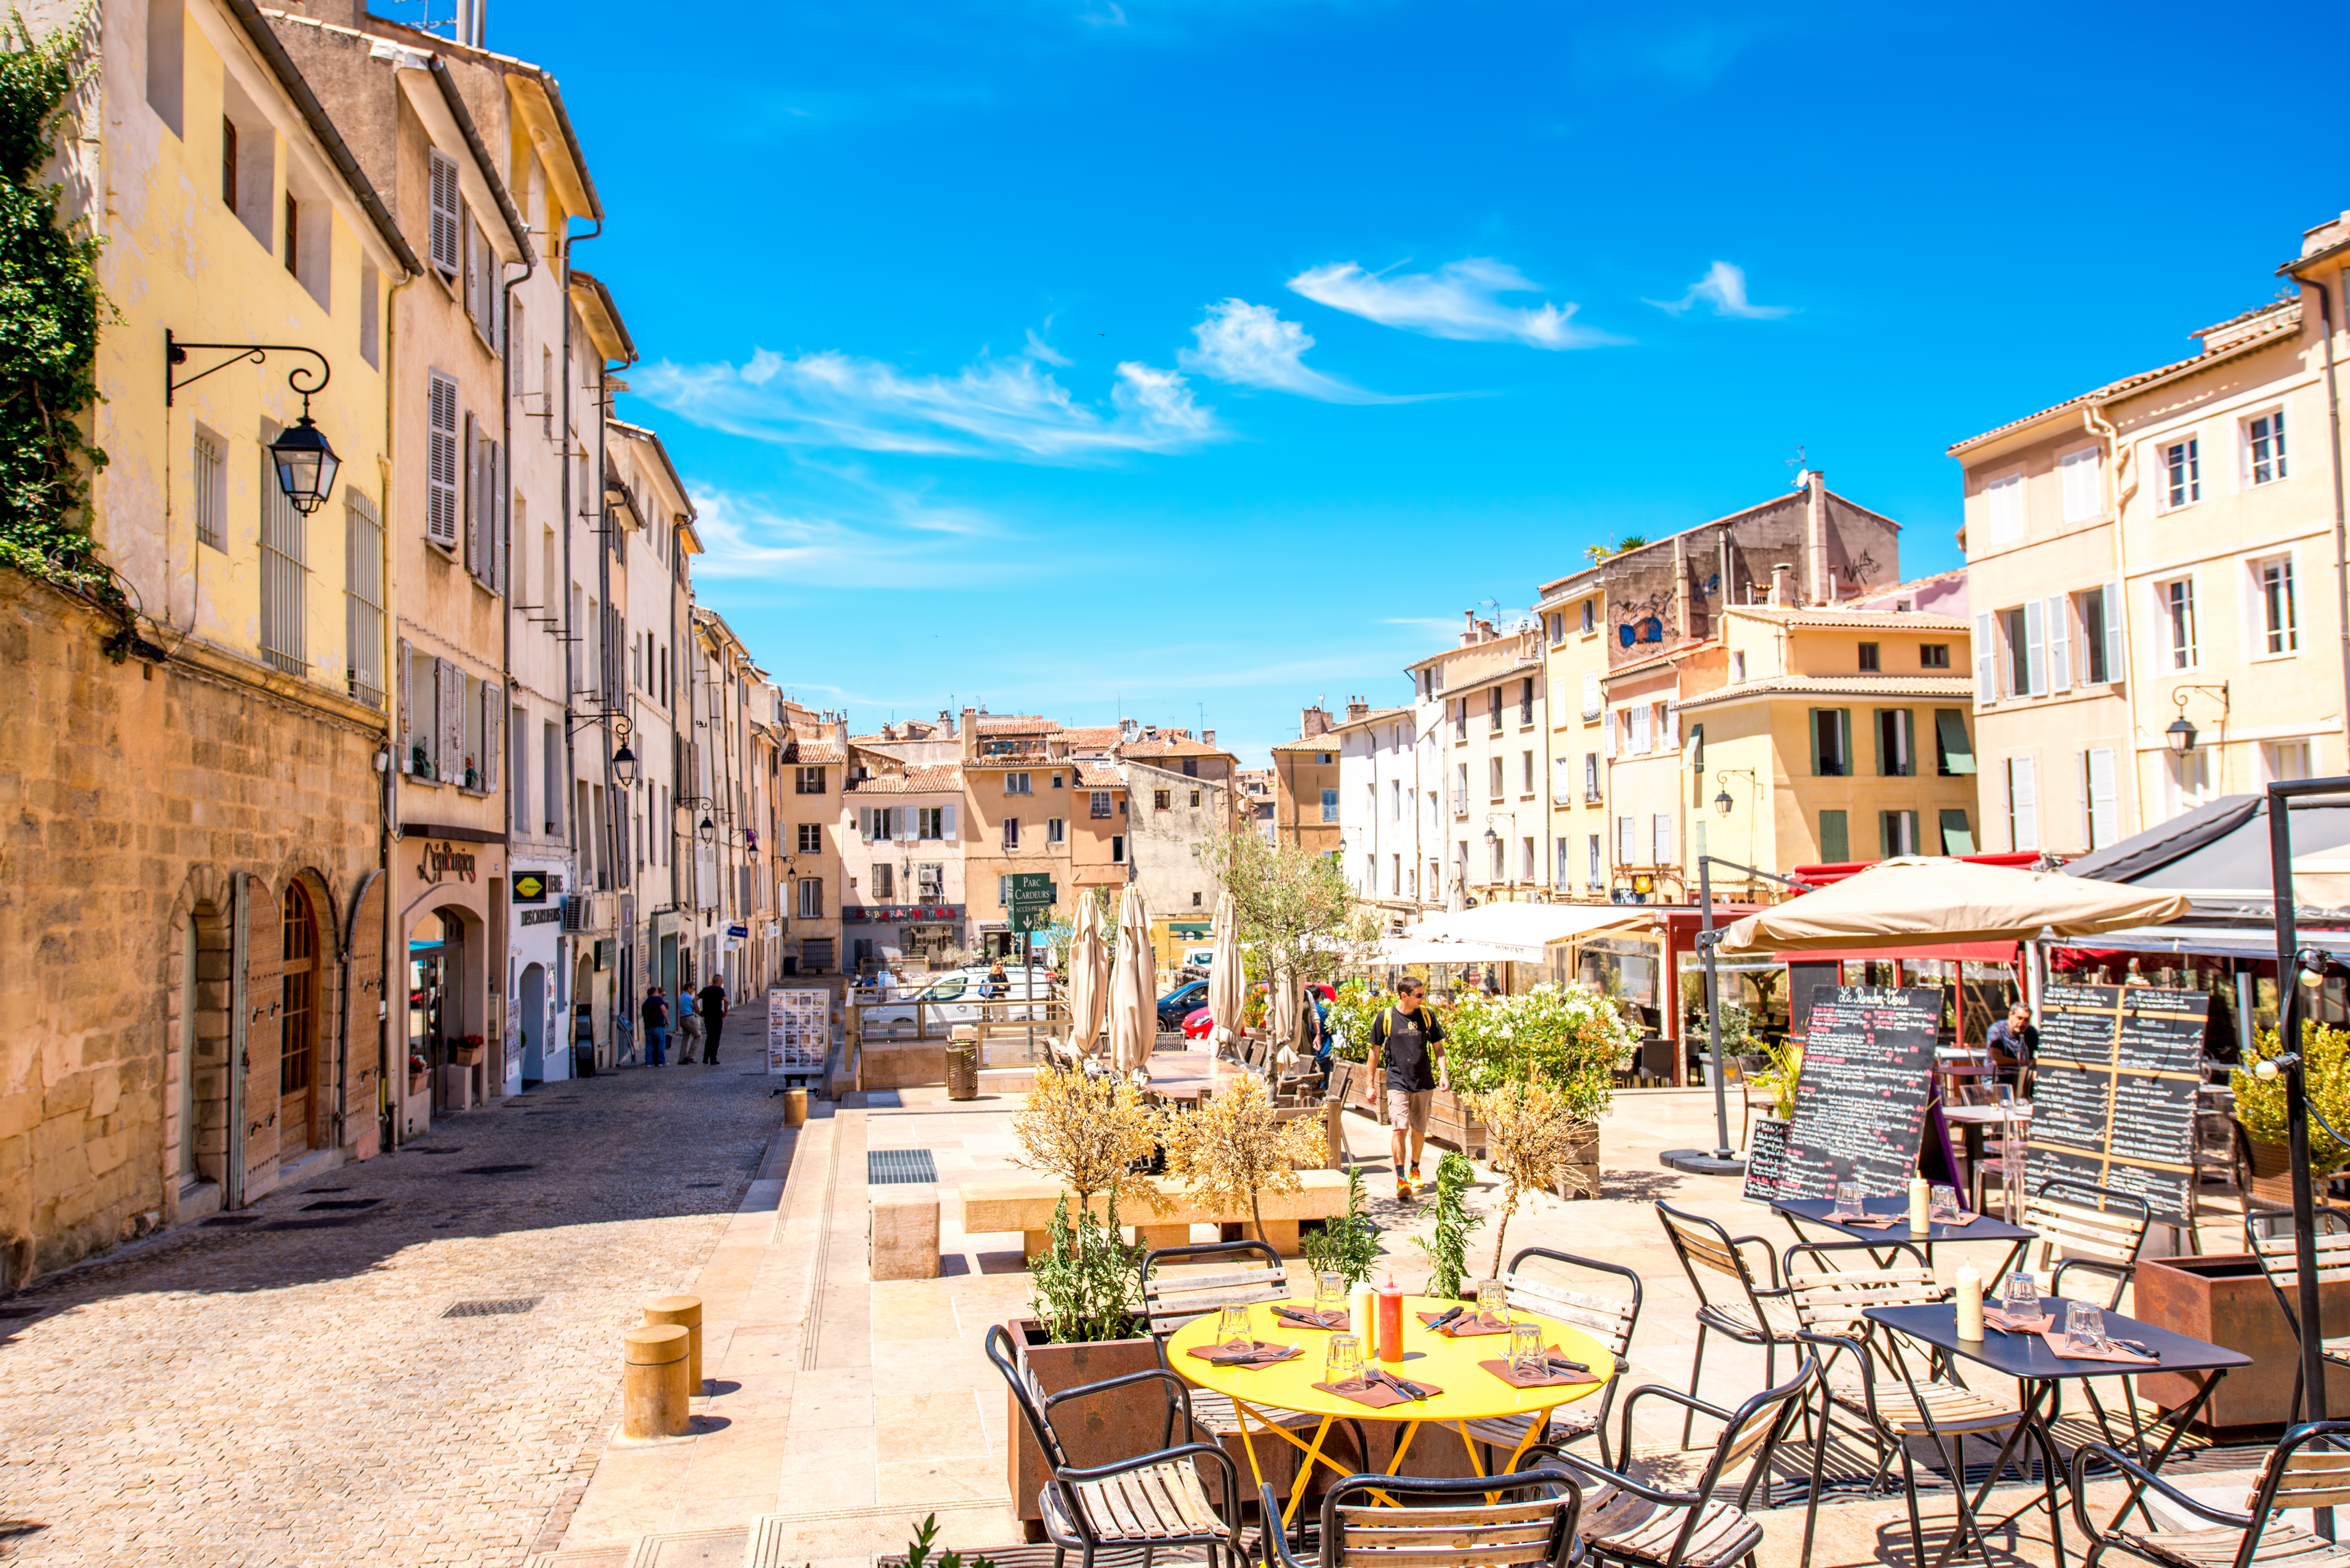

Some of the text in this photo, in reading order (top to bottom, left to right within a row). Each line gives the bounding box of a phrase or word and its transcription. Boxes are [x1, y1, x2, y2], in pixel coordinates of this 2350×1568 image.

[1023, 877, 1042, 887] PARC
[1015, 889, 1050, 900] CARDEURS
[873, 907, 955, 921] BARATINURS
[1407, 1021, 1418, 1030] 68
